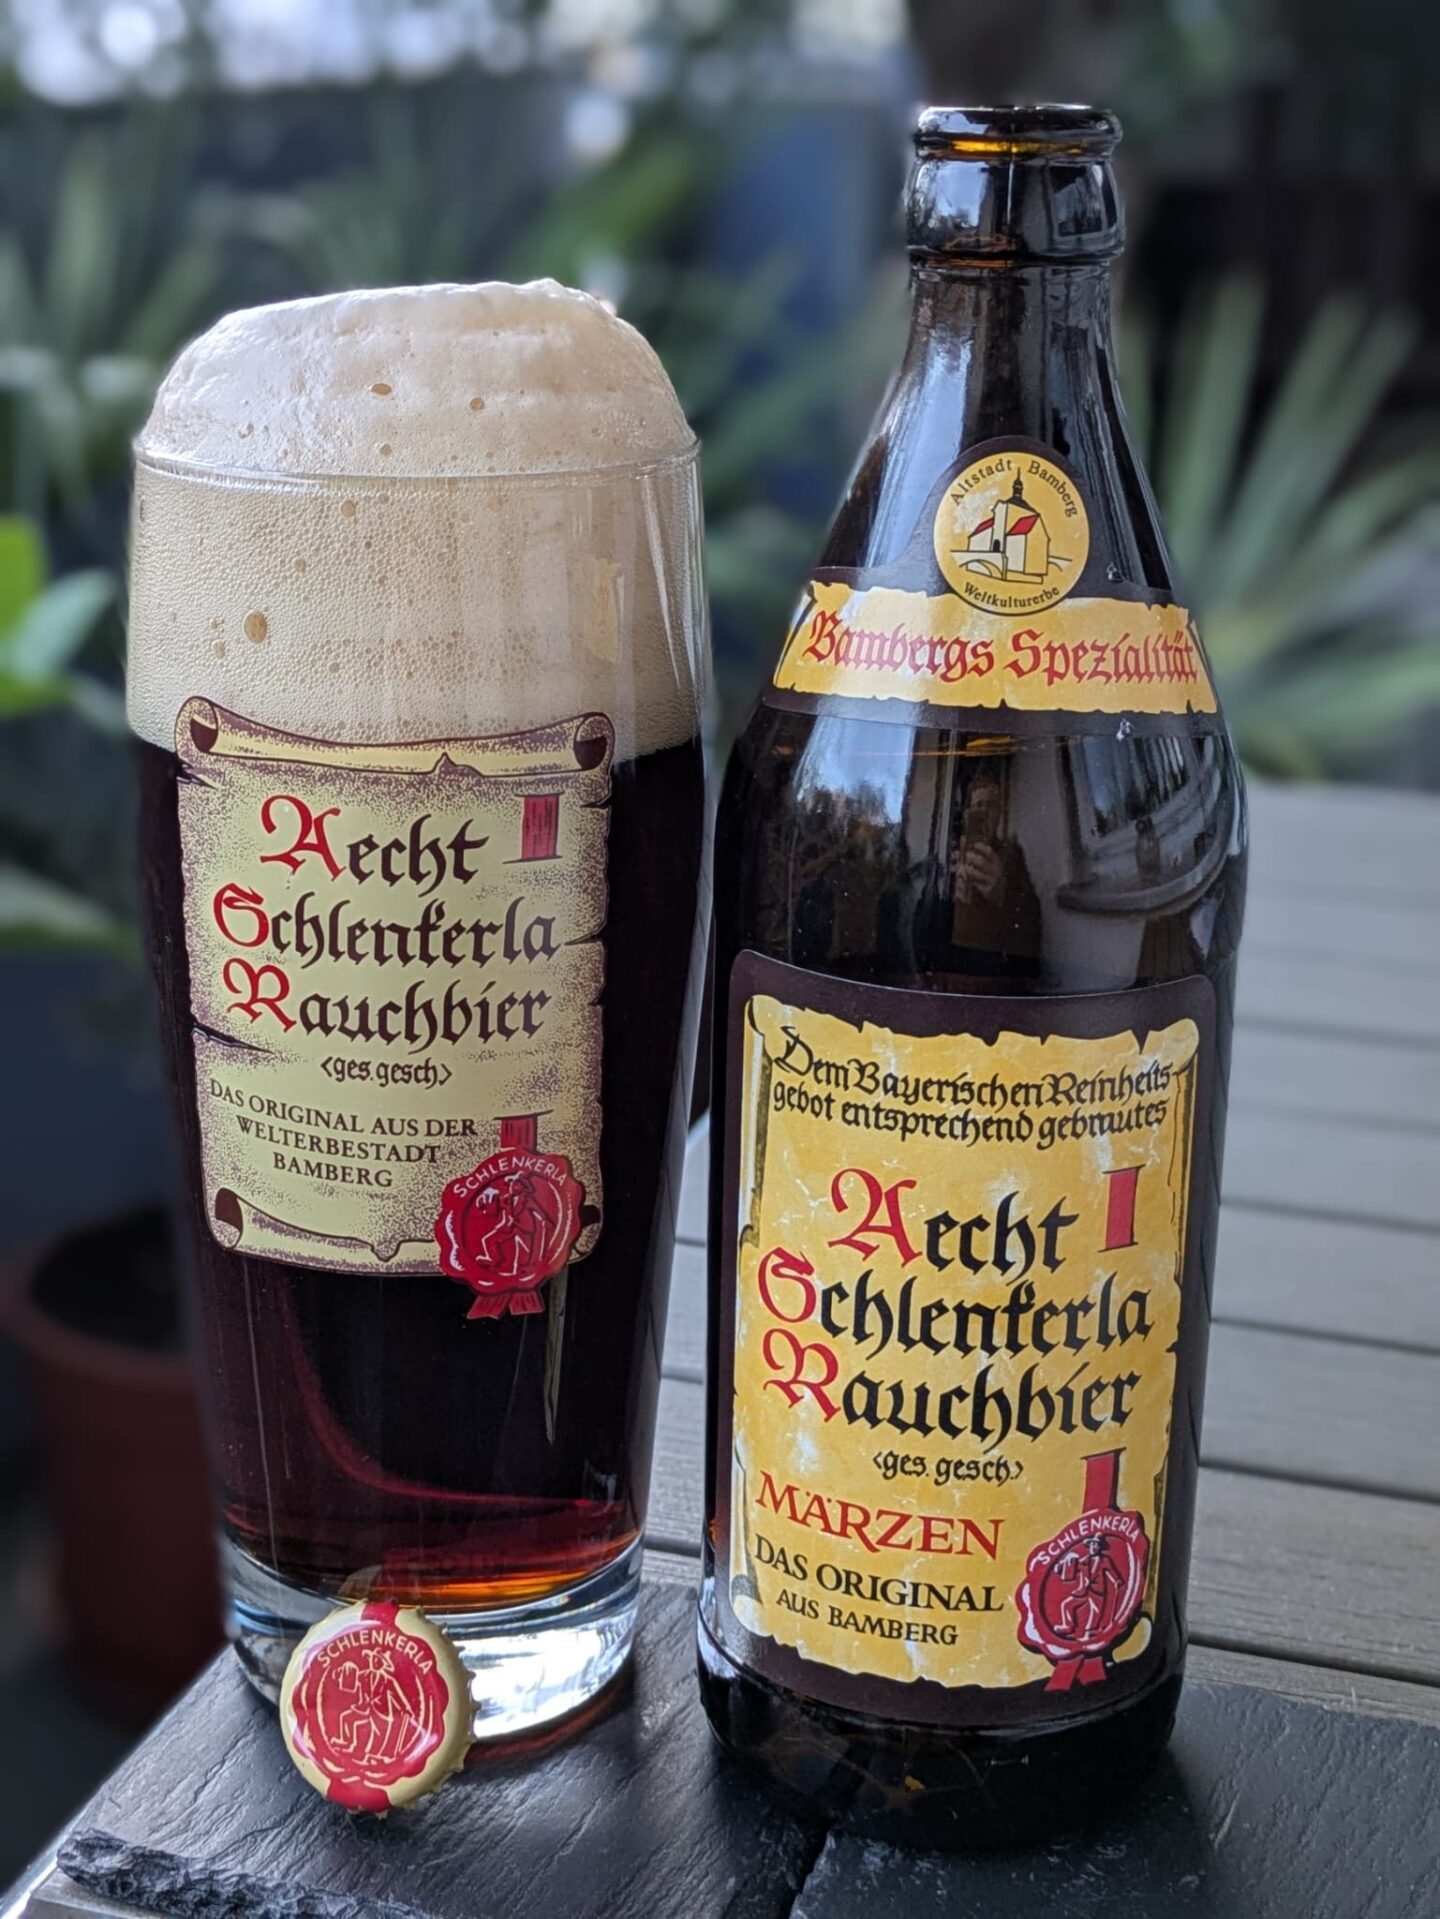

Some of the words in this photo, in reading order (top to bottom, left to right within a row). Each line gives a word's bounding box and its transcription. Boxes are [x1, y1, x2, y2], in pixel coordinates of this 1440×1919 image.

[950, 458, 1012, 506] Altstadt
[1027, 460, 1077, 518] Bamberg
[963, 582, 1060, 608] Weltkulturerbe
[802, 610, 994, 683] Bambergs
[1003, 629, 1197, 686] Spezialität
[260, 794, 489, 898] Aecht
[213, 883, 560, 969] Schlenkerla
[223, 957, 551, 1054] Rauchbier
[210, 1078, 244, 1107] DAS
[249, 1095, 363, 1133] ORIGINAL
[371, 1118, 418, 1137] AUS
[425, 1118, 477, 1137] DER
[236, 1115, 440, 1164] WELTERBESTADT
[774, 1081, 835, 1121] gebot
[841, 1101, 1033, 1147] entsprechend
[1036, 1097, 1170, 1150] gebrautes
[274, 1152, 392, 1188] BAMBERG
[453, 1156, 567, 1198] SCHLENKERLA
[827, 1167, 1080, 1287] Aecht
[758, 1246, 1155, 1360] Schlenkerla
[762, 1328, 1142, 1455] Rauchbier
[755, 1470, 1004, 1560] MÄRZEN
[1038, 1516, 1140, 1565] SCHLENKERLA
[754, 1534, 808, 1582] DAS
[816, 1563, 1004, 1613] ORIGINAL
[775, 1587, 819, 1619] AUS
[829, 1607, 958, 1646] BAMBERG
[317, 1630, 433, 1675] SCHLENKERLA
